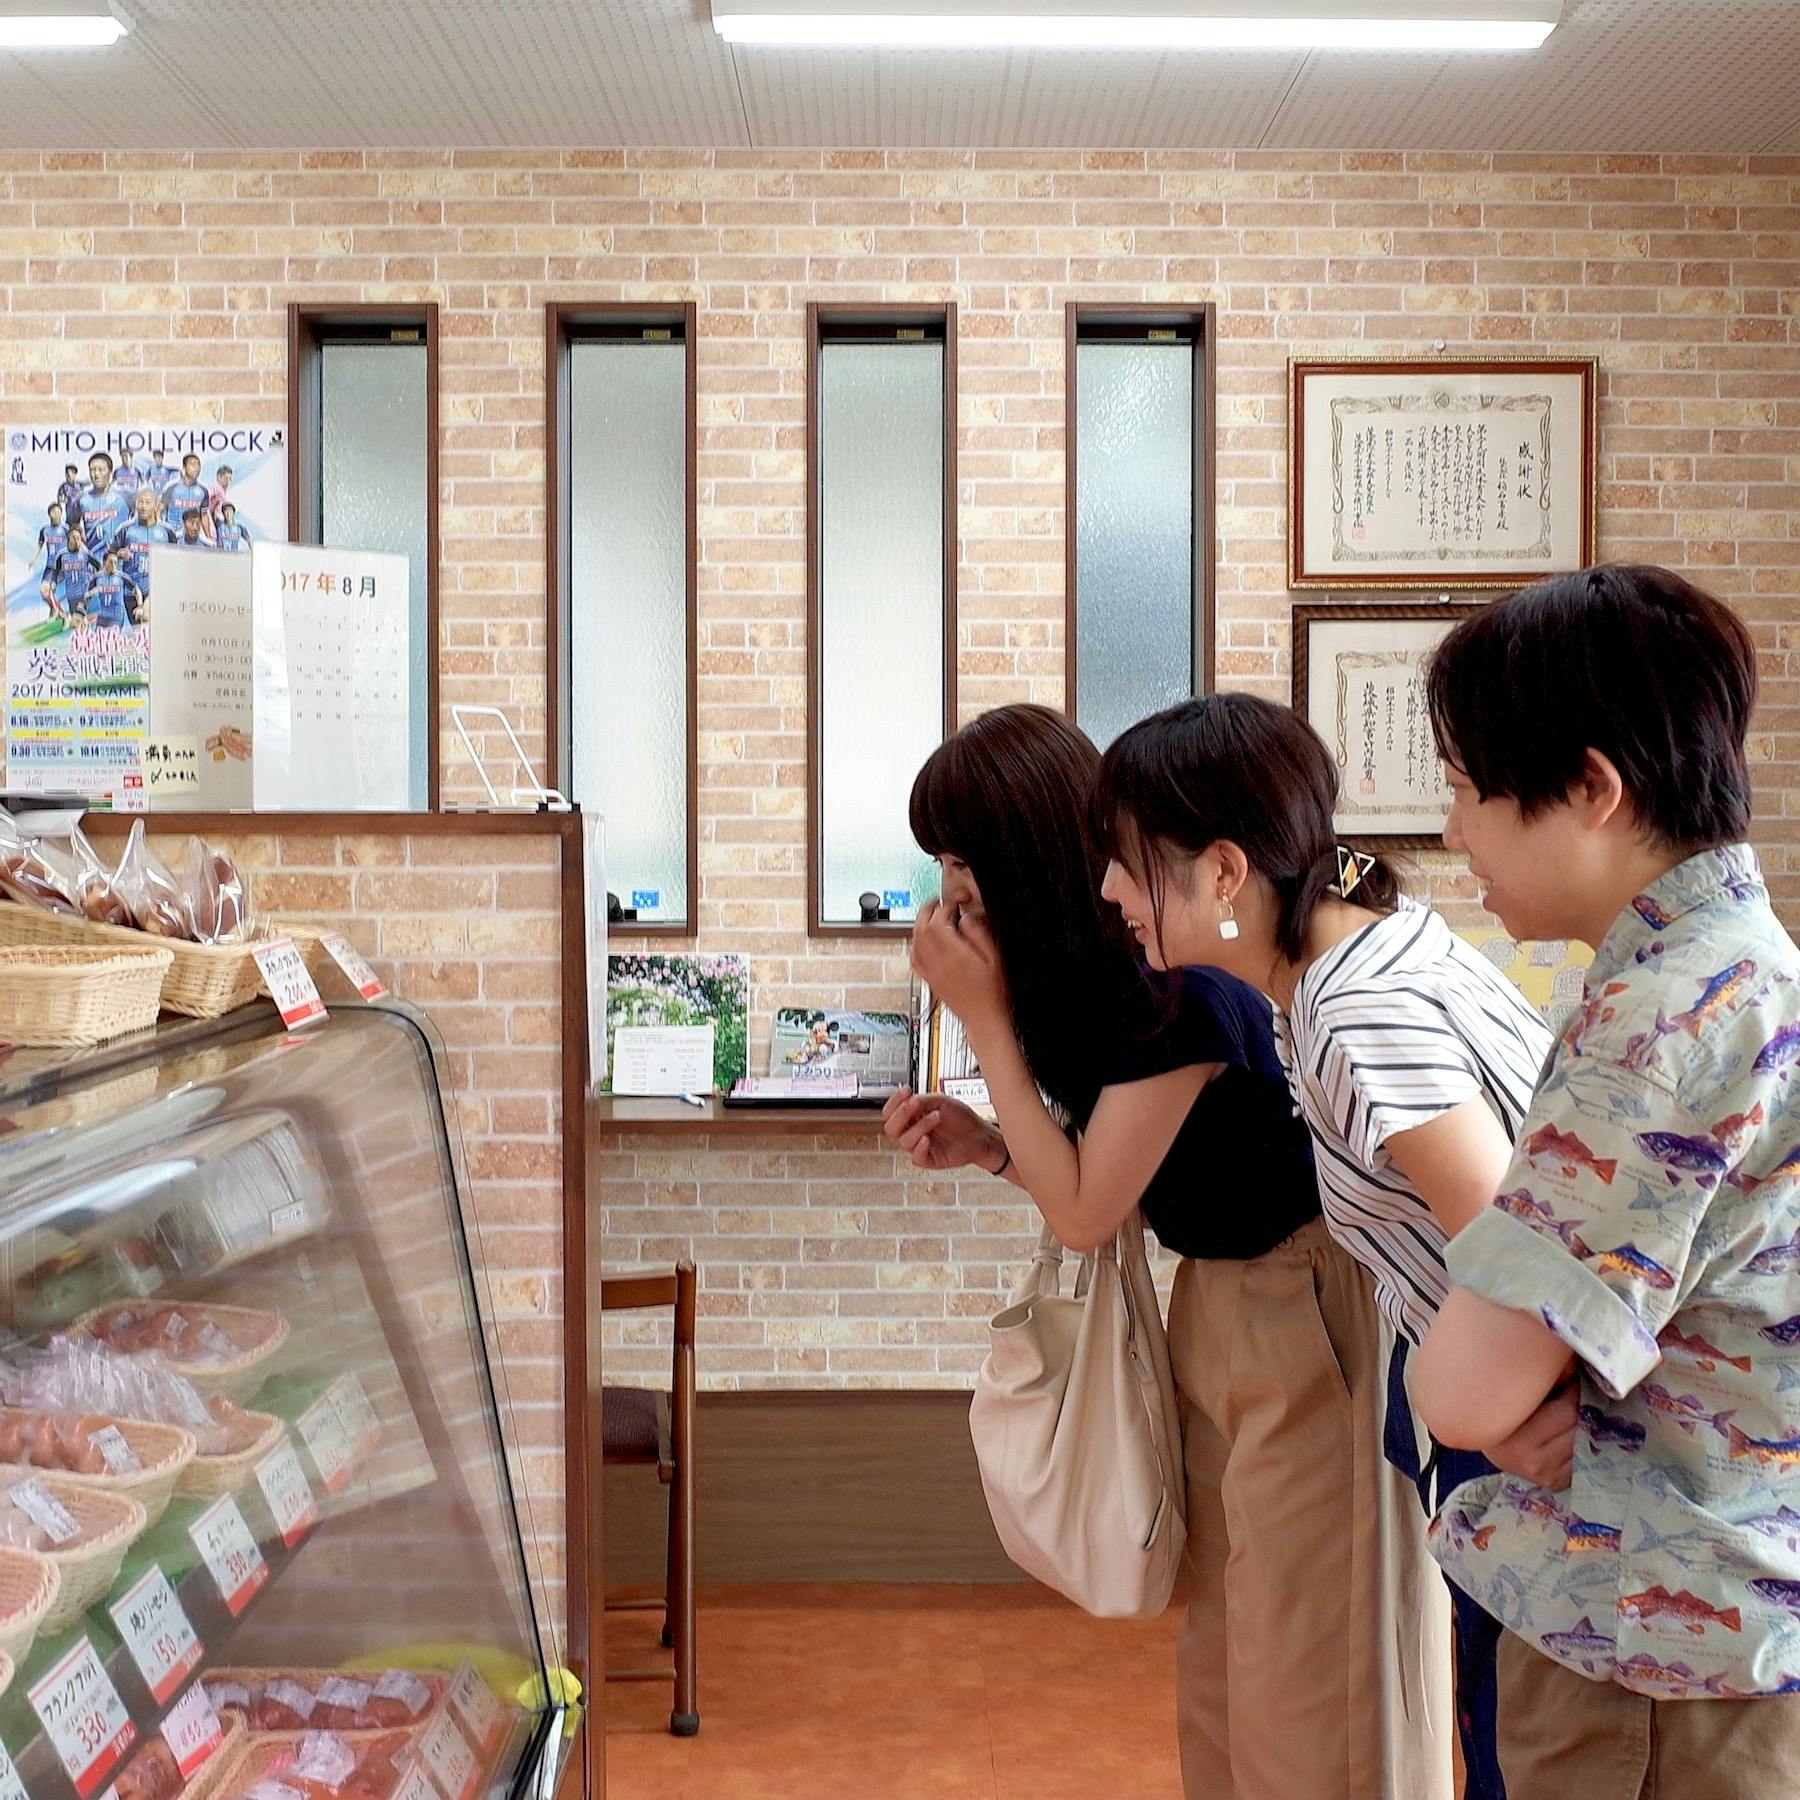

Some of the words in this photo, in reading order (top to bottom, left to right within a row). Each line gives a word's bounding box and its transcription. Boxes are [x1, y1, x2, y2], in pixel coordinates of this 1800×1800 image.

[31, 430, 96, 453] MITO
[107, 430, 265, 453] HOLLYHOCK
[12, 683, 44, 698] 2017
[50, 683, 141, 698] HOMEGAME
[76, 1709, 109, 1755] 330
